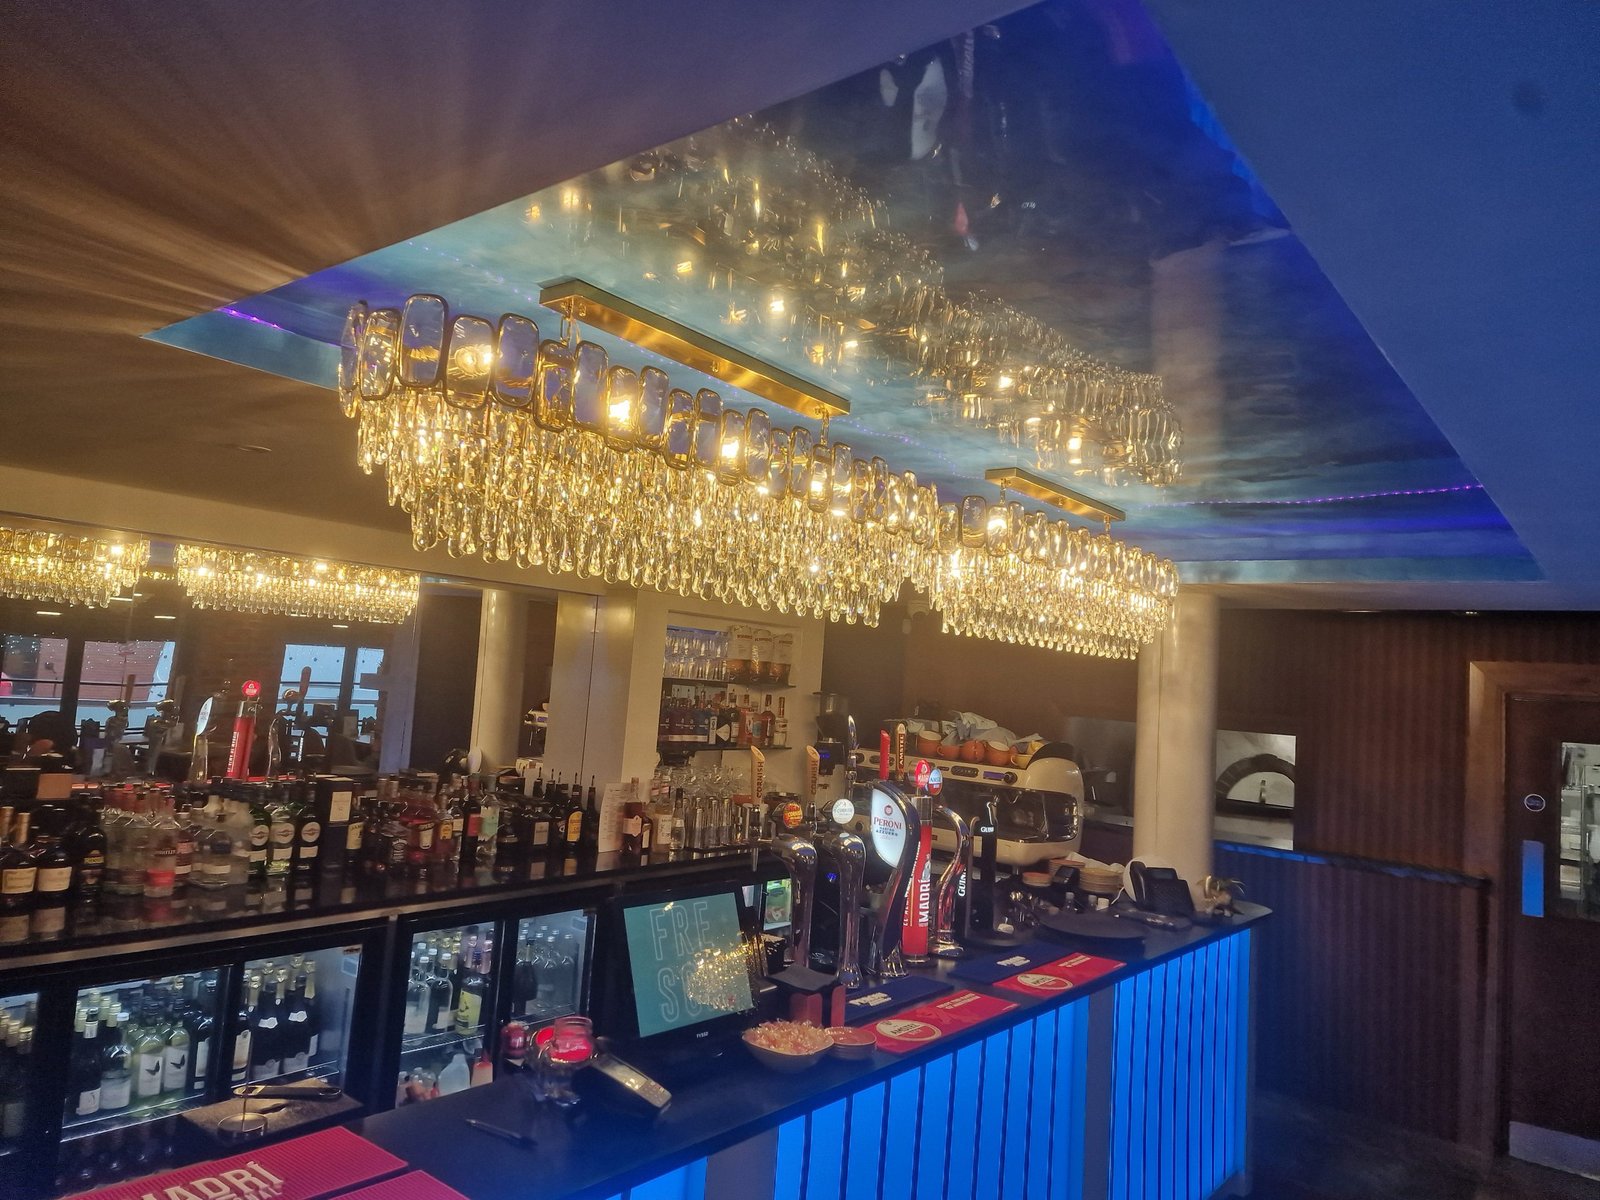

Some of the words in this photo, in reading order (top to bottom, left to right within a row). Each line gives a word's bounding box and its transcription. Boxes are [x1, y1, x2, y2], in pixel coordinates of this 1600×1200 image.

[756, 761, 764, 799] CORNISH
[810, 760, 818, 795] CORNISH
[873, 816, 902, 830] PERONI
